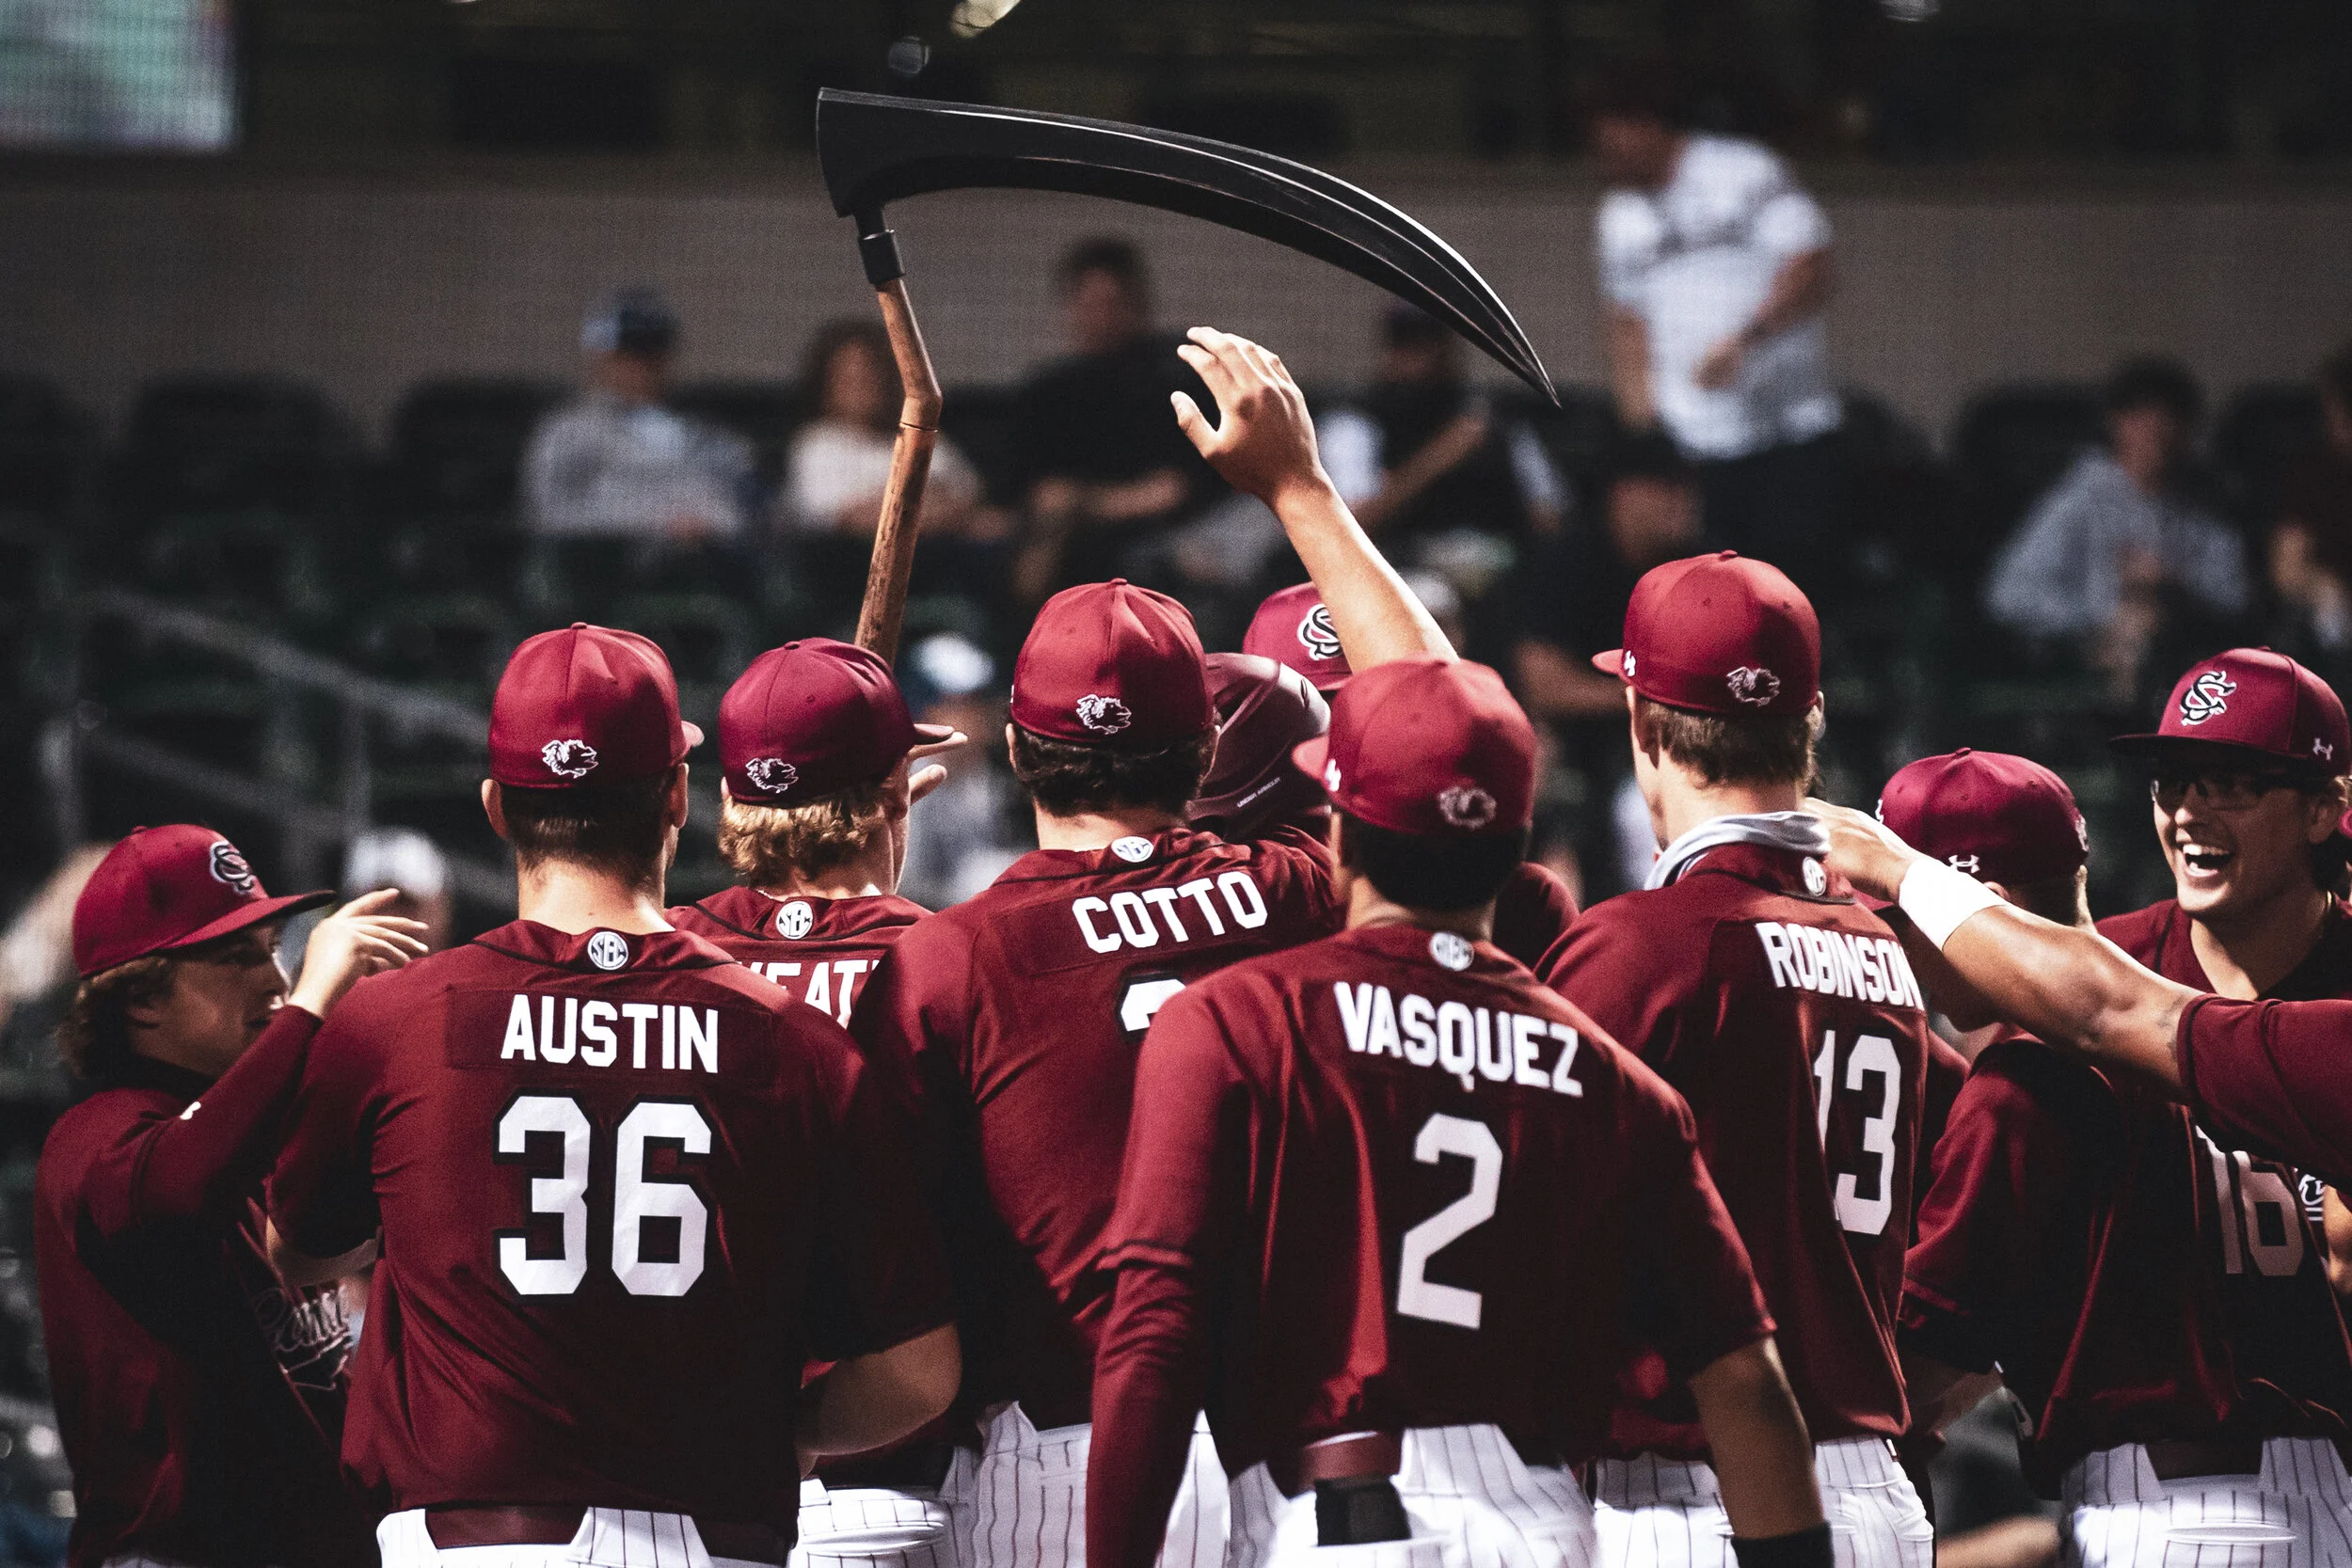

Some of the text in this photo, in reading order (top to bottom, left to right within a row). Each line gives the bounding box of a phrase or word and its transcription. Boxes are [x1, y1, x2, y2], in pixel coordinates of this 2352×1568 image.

[590, 933, 628, 969] SEC
[1072, 870, 1268, 953] COTTO
[1755, 921, 1926, 1012] ROBINSON
[500, 993, 719, 1074] AUSTIN
[1333, 981, 1583, 1098] VASQUEZ
[1813, 1029, 1901, 1236] 13
[498, 1095, 712, 1297] 36
[1397, 1113, 1503, 1329] 2
